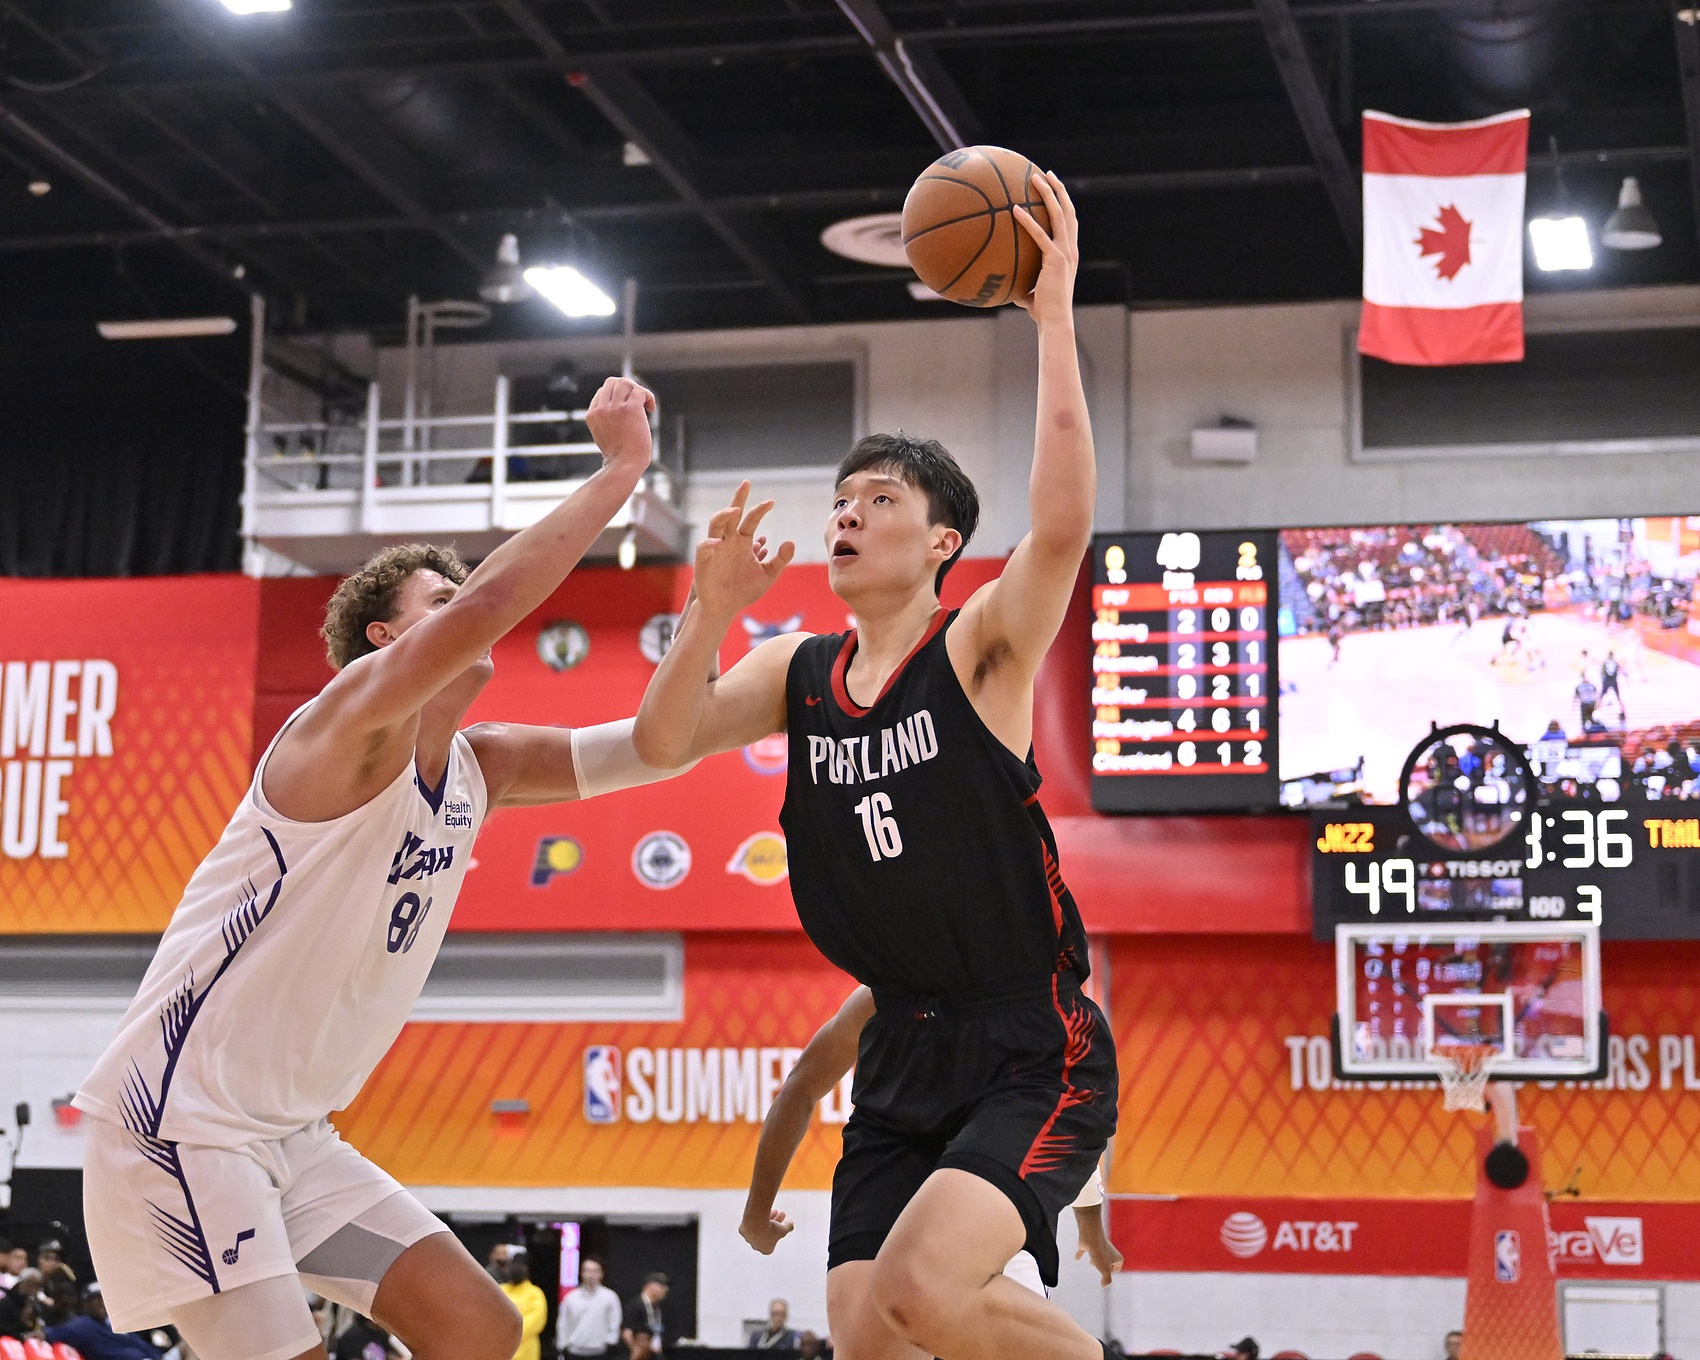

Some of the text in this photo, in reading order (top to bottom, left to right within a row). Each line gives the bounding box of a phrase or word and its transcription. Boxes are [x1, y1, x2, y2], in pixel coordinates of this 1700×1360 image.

[1176, 608, 1196, 634] 2
[1211, 607, 1231, 632] 0
[1240, 606, 1259, 632] 0
[1176, 643, 1197, 669] 2
[1212, 641, 1231, 667] 3
[1245, 640, 1260, 666] 1
[1211, 674, 1231, 700] 2
[1245, 673, 1260, 698] 1
[0, 659, 119, 758] MER
[1176, 707, 1197, 733] 4
[1211, 707, 1231, 733] 6
[1245, 708, 1260, 733] 1
[806, 709, 939, 785] PORTLAND
[1177, 740, 1197, 767] 6
[1216, 741, 1231, 767] 1
[1243, 740, 1262, 766] 2
[0, 760, 74, 859] UE
[444, 801, 472, 814] Health
[445, 814, 473, 829] Equity
[854, 791, 903, 862] 16
[1446, 859, 1523, 878] TISSOT
[1344, 858, 1416, 915] 49
[386, 891, 433, 955] 88
[1272, 1220, 1360, 1252] AT&T
